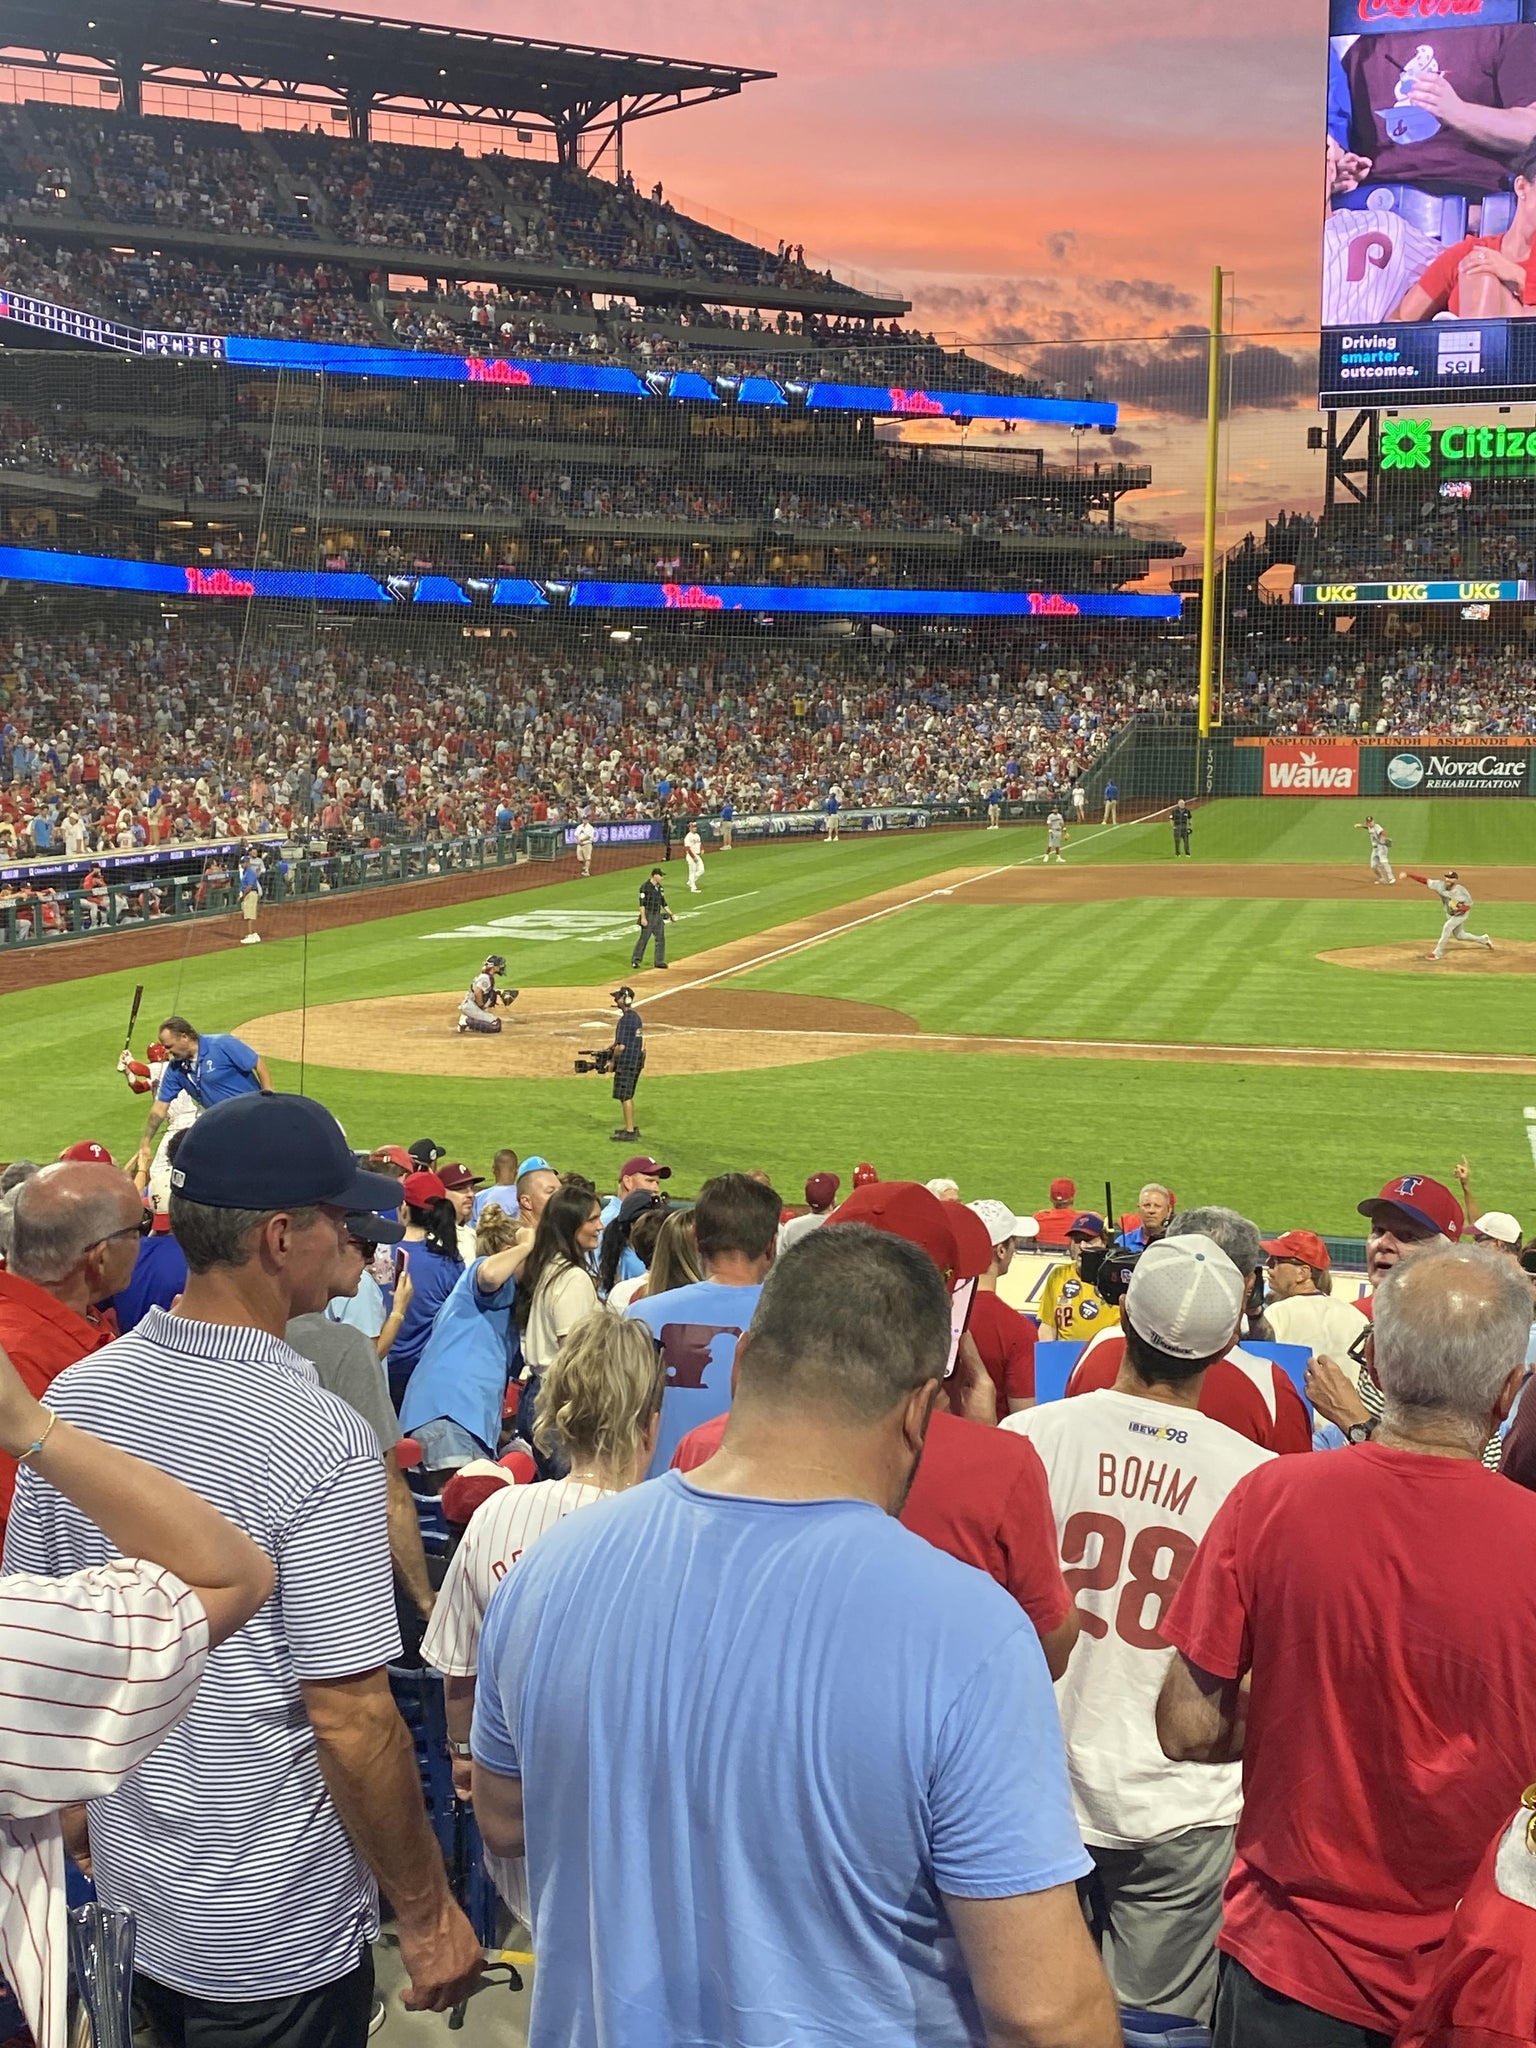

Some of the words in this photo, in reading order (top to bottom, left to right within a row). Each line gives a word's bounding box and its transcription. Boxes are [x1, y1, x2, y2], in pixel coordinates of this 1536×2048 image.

[1346, 231, 1393, 282] P
[13, 297, 19, 307] 0
[29, 301, 35, 312] 0
[44, 306, 50, 316] 0
[61, 311, 67, 320] 0
[75, 315, 81, 325] 0
[89, 319, 95, 329] 0
[105, 323, 111, 333] 0
[146, 337, 156, 349] R
[160, 335, 168, 344] 0
[172, 339, 183, 351] H
[187, 337, 194, 346] 3
[199, 341, 208, 353] E
[213, 339, 221, 348] 0
[1342, 335, 1397, 349] Driving
[160, 346, 168, 355] 4
[187, 347, 194, 357] 7
[1341, 350, 1400, 364] smarter
[465, 357, 531, 386] Phillies
[1340, 365, 1419, 378] outcomes.
[888, 386, 944, 414] Phillies
[185, 566, 254, 596] Phillies
[662, 583, 723, 609] Phillies
[1316, 585, 1357, 602] UKG
[1387, 584, 1428, 600] UKG
[1459, 583, 1500, 600] UKG
[1027, 592, 1080, 615] Phillies
[1267, 737, 1337, 746] ASPLUNDH
[1352, 737, 1422, 746] ASPLUNDH
[1436, 737, 1509, 746] ASPLUNDH
[1206, 749, 1214, 793] 329
[1425, 755, 1527, 777] NovaCare
[1269, 762, 1353, 789] Wawa
[1426, 779, 1522, 789] REHABILITATION
[610, 824, 652, 841] BAKERY
[1128, 1421, 1159, 1437] IBEW
[1165, 1427, 1188, 1444] 98
[1098, 1453, 1198, 1516] BOHM
[1061, 1511, 1199, 1650] 28
